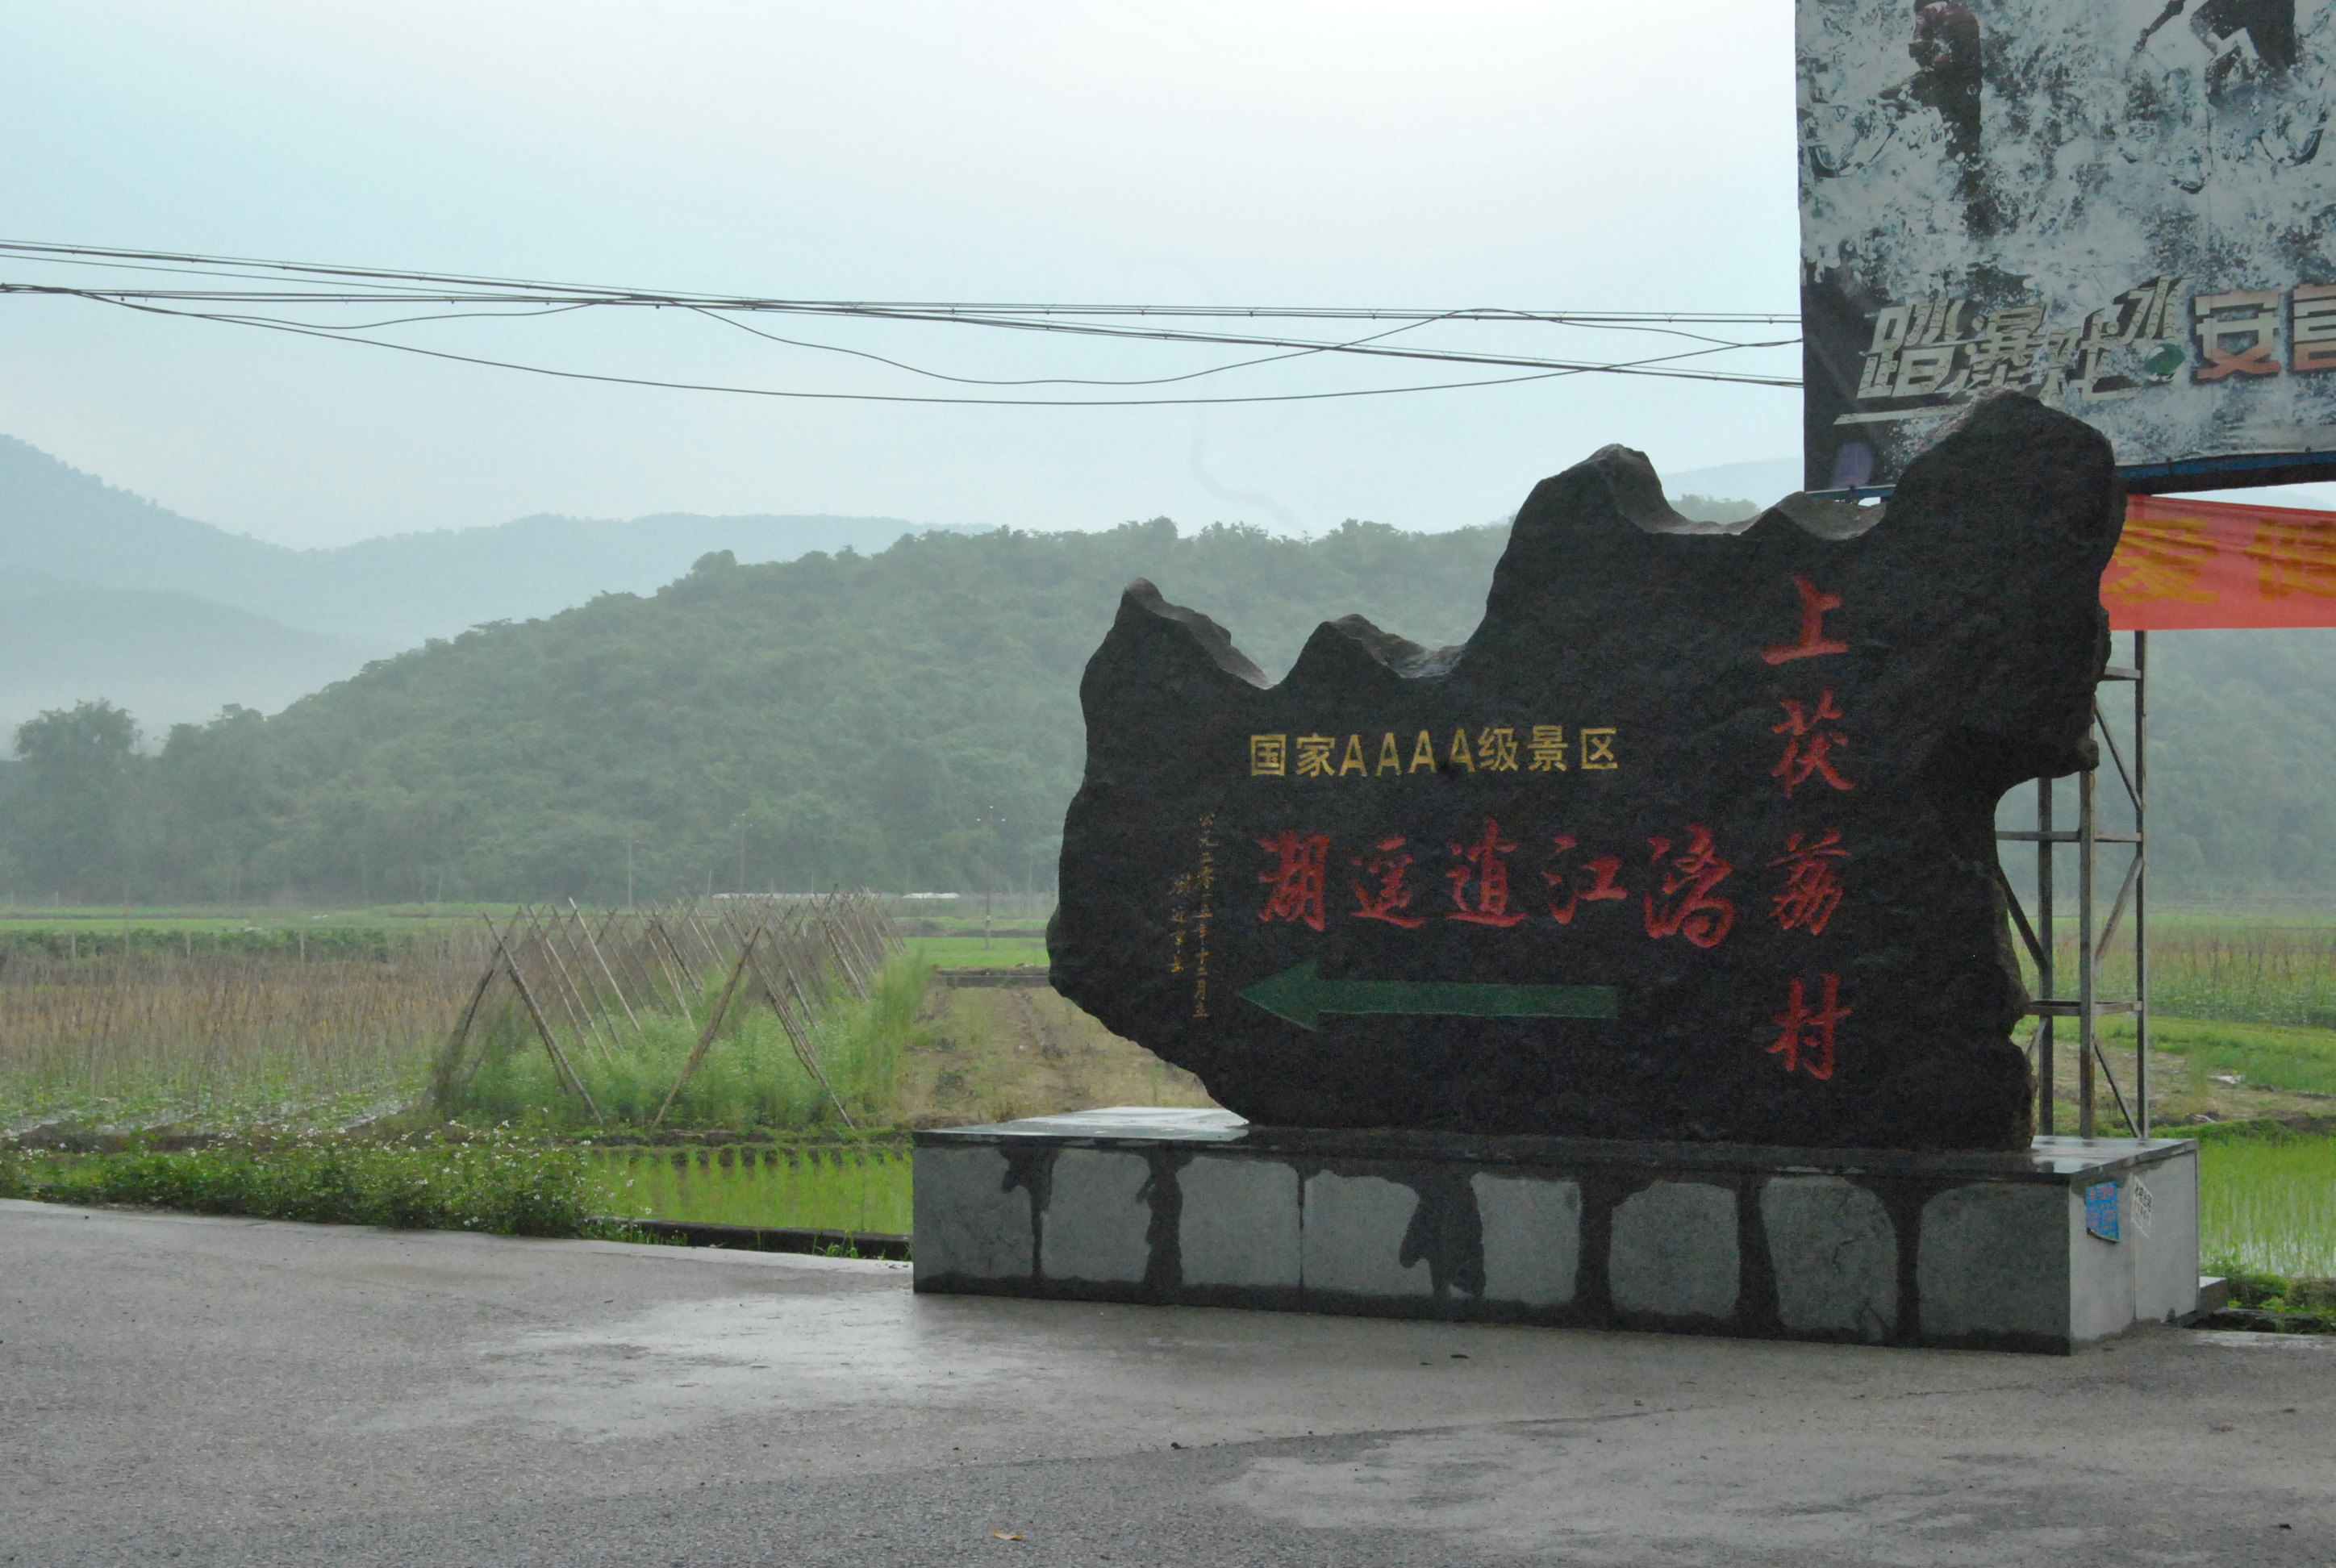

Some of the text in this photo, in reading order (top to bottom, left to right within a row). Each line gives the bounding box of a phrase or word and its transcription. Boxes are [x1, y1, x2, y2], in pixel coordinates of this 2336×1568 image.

[1249, 725, 1617, 778] 国家AAAA级景区
